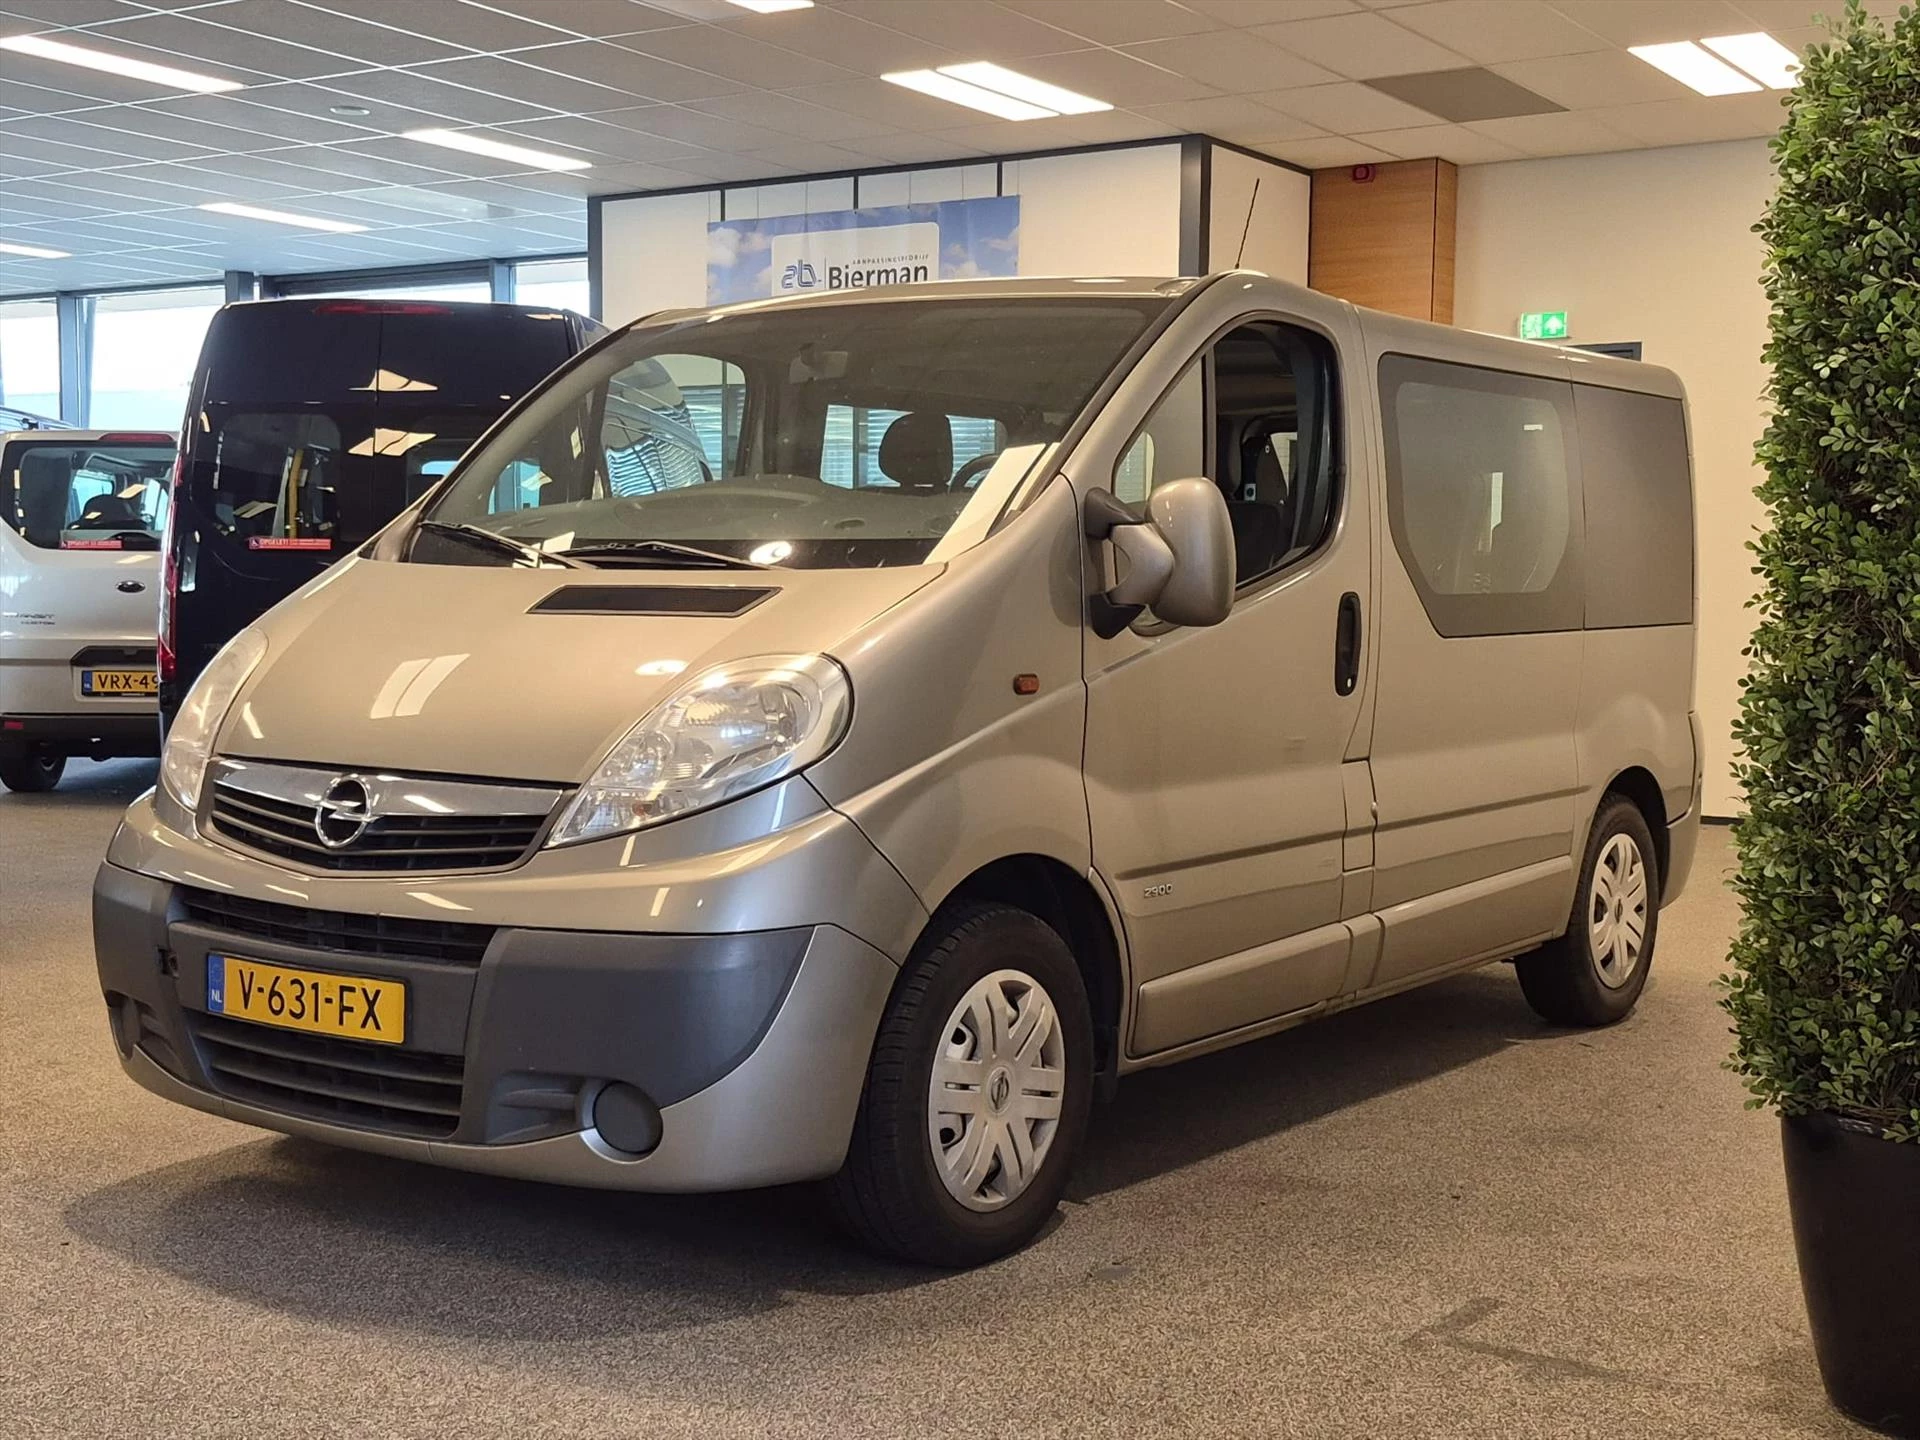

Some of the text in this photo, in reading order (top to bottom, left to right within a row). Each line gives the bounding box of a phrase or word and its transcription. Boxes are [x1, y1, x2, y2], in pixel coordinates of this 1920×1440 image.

[828, 264, 929, 289] Bierman
[1144, 884, 1173, 898] 2900
[211, 969, 382, 1031] NL V-631-FX
